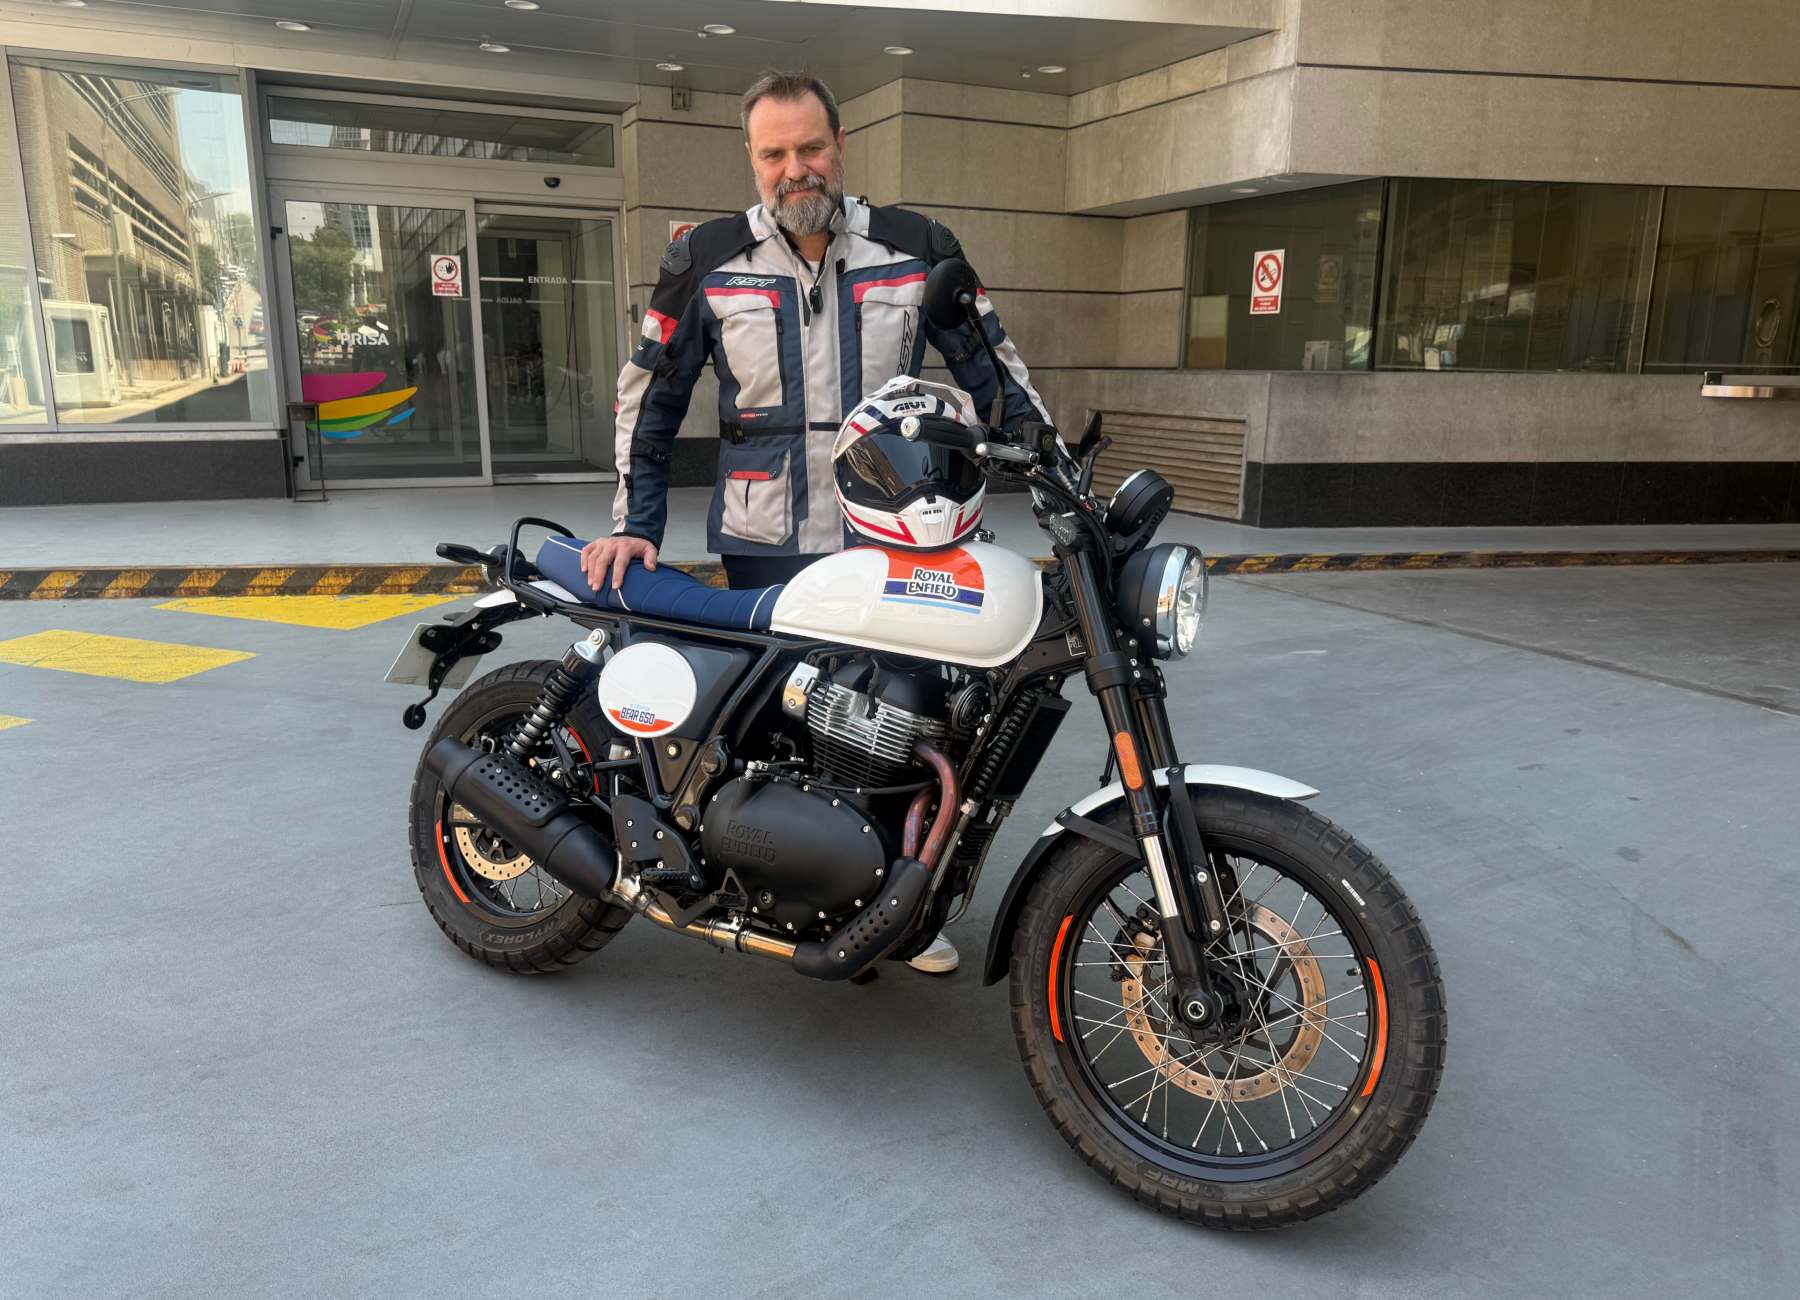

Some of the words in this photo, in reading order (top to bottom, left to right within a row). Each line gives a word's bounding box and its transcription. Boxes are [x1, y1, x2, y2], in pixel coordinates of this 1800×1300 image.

[527, 275, 568, 285] ENTRADA
[726, 277, 777, 288] RST
[340, 332, 390, 346] PRISA
[892, 401, 927, 412] GIVI
[913, 566, 953, 584] ROYAL
[908, 582, 957, 598] ENFIELD
[620, 707, 640, 721] BEAR
[638, 711, 656, 725] 650
[726, 818, 773, 845] ROYAL
[485, 919, 556, 945] NYLOREX
[1143, 1169, 1200, 1194] MRF
